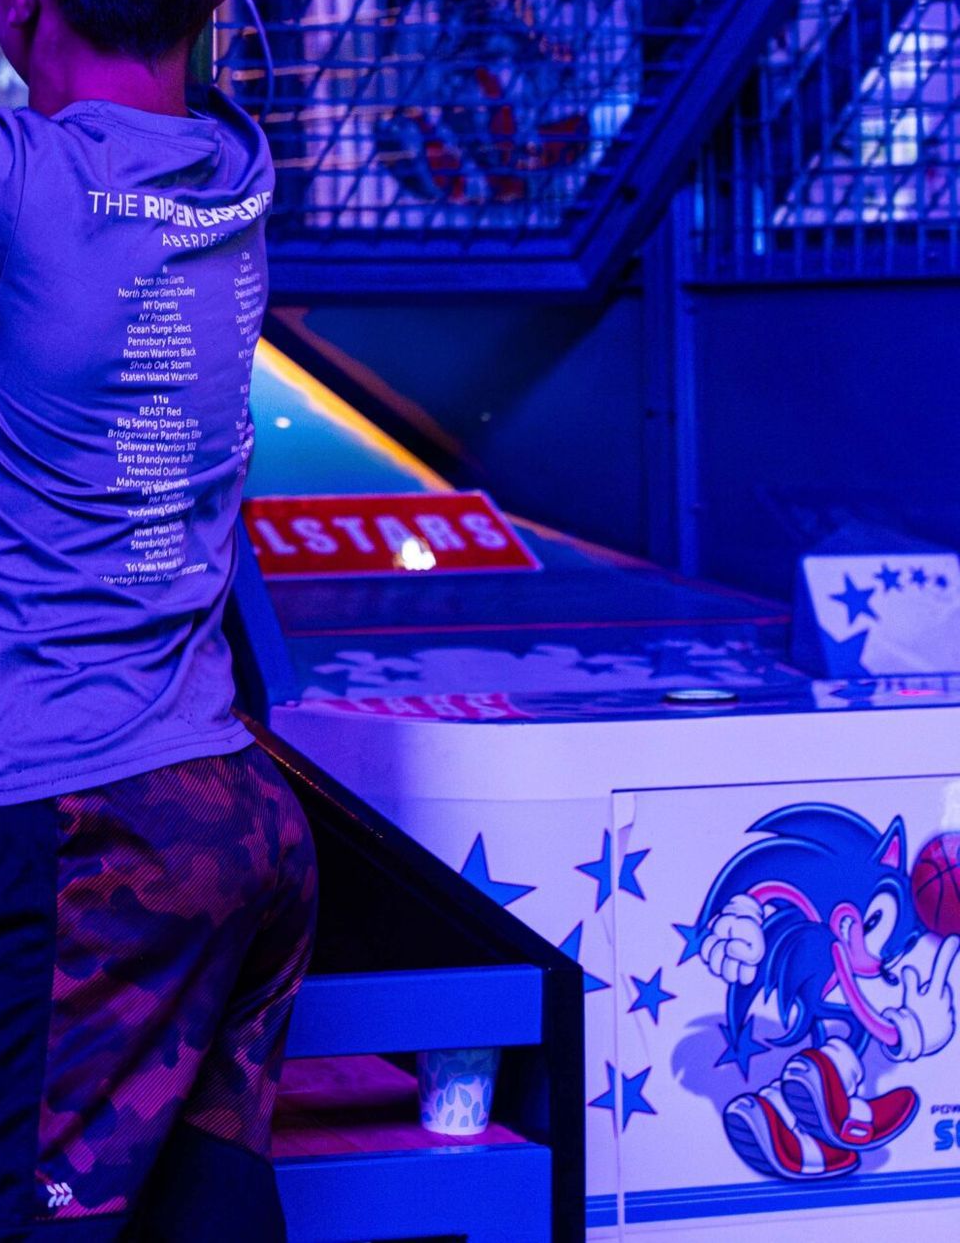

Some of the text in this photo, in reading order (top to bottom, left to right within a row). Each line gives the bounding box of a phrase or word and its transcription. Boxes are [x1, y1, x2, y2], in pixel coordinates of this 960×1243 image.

[88, 190, 138, 216] THE
[144, 195, 198, 228] RIPEN
[118, 288, 140, 298] North
[143, 301, 178, 312] NY Dynasty
[150, 312, 181, 323] Prospects
[127, 325, 150, 334] Ocean
[151, 325, 172, 335] Surge
[128, 336, 192, 347] Pennsbury Falcons
[123, 349, 149, 358] Reston
[150, 349, 180, 358] Warriors
[130, 360, 191, 370] Shrub Oak Storm
[120, 372, 146, 382] Staten
[147, 372, 170, 381] Island
[152, 394, 169, 405] 11u
[139, 406, 181, 417] BEAST Red
[117, 417, 131, 429] Big
[132, 418, 158, 430] Spring
[159, 419, 185, 430] Dawgs
[108, 429, 159, 441] Bridgewater
[160, 430, 190, 440] Panthers
[116, 441, 155, 451] Delaware
[156, 442, 185, 452] Warriors
[117, 453, 135, 463] East
[136, 454, 180, 466] Brandywine
[126, 465, 162, 475] Freehold
[253, 513, 508, 556] LSTARS
